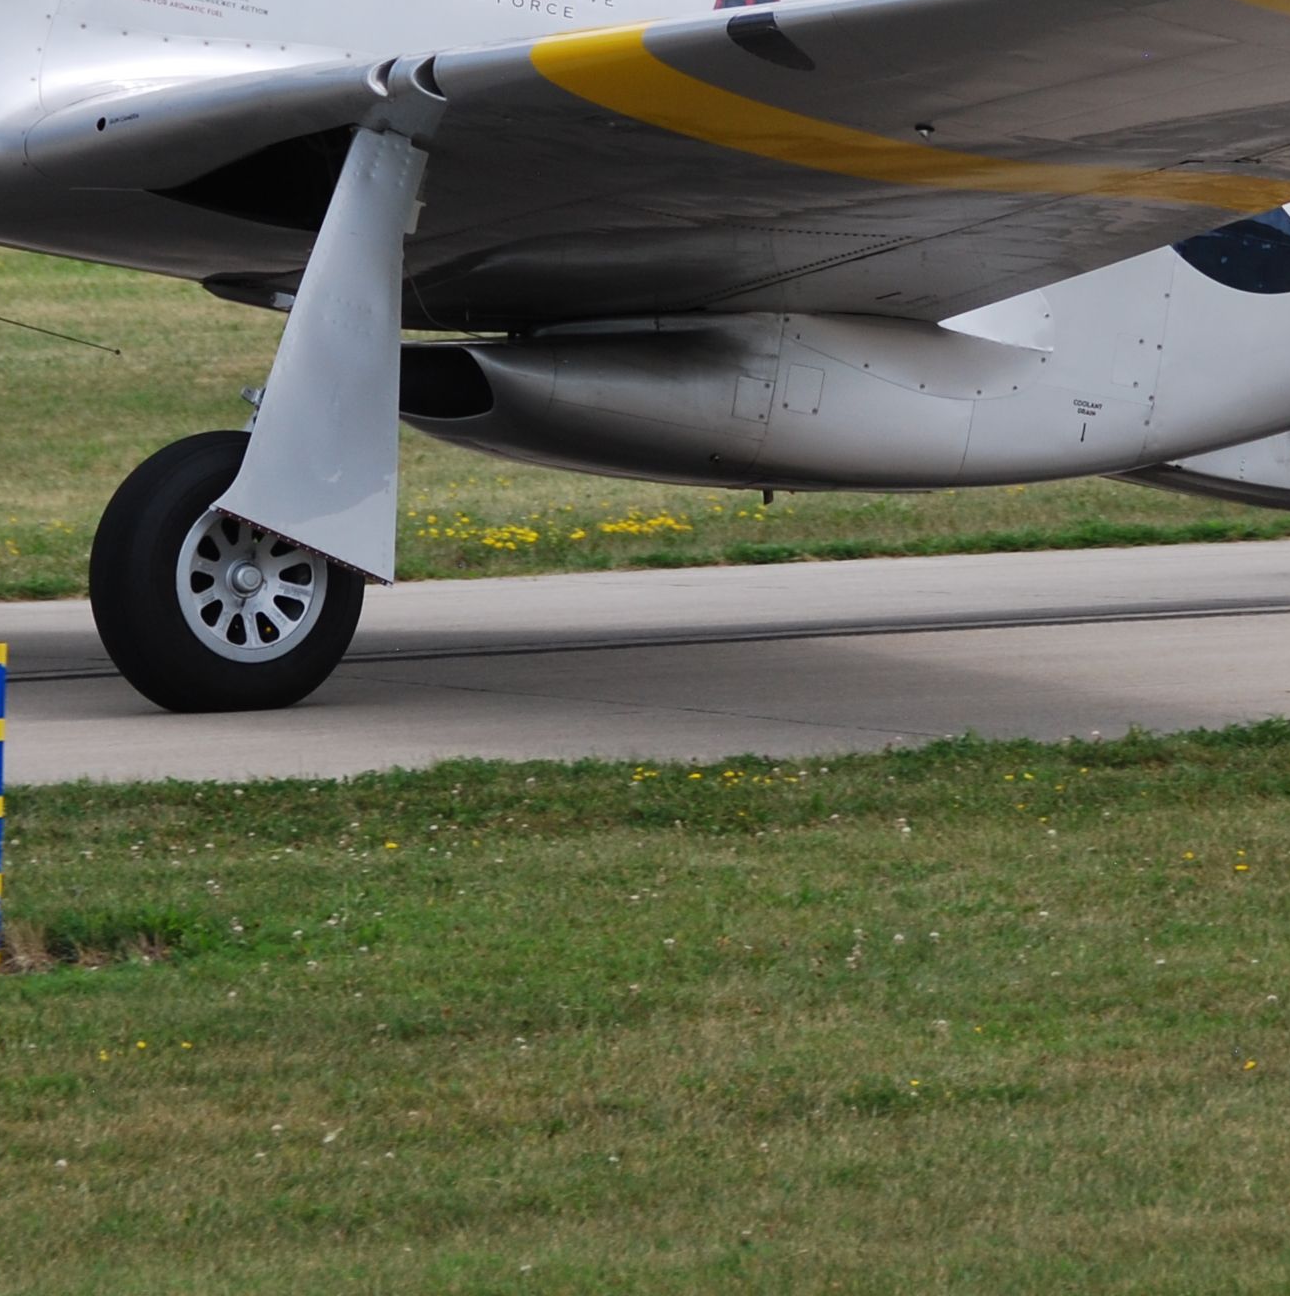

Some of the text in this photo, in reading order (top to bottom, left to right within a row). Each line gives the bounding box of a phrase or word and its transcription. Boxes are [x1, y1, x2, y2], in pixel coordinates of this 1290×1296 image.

[169, 1, 206, 15] AROMATIC
[207, 8, 224, 18] FUEL
[240, 3, 269, 16] ACTION
[1073, 399, 1102, 410] COOLANT
[1077, 407, 1096, 416] DRAIN
